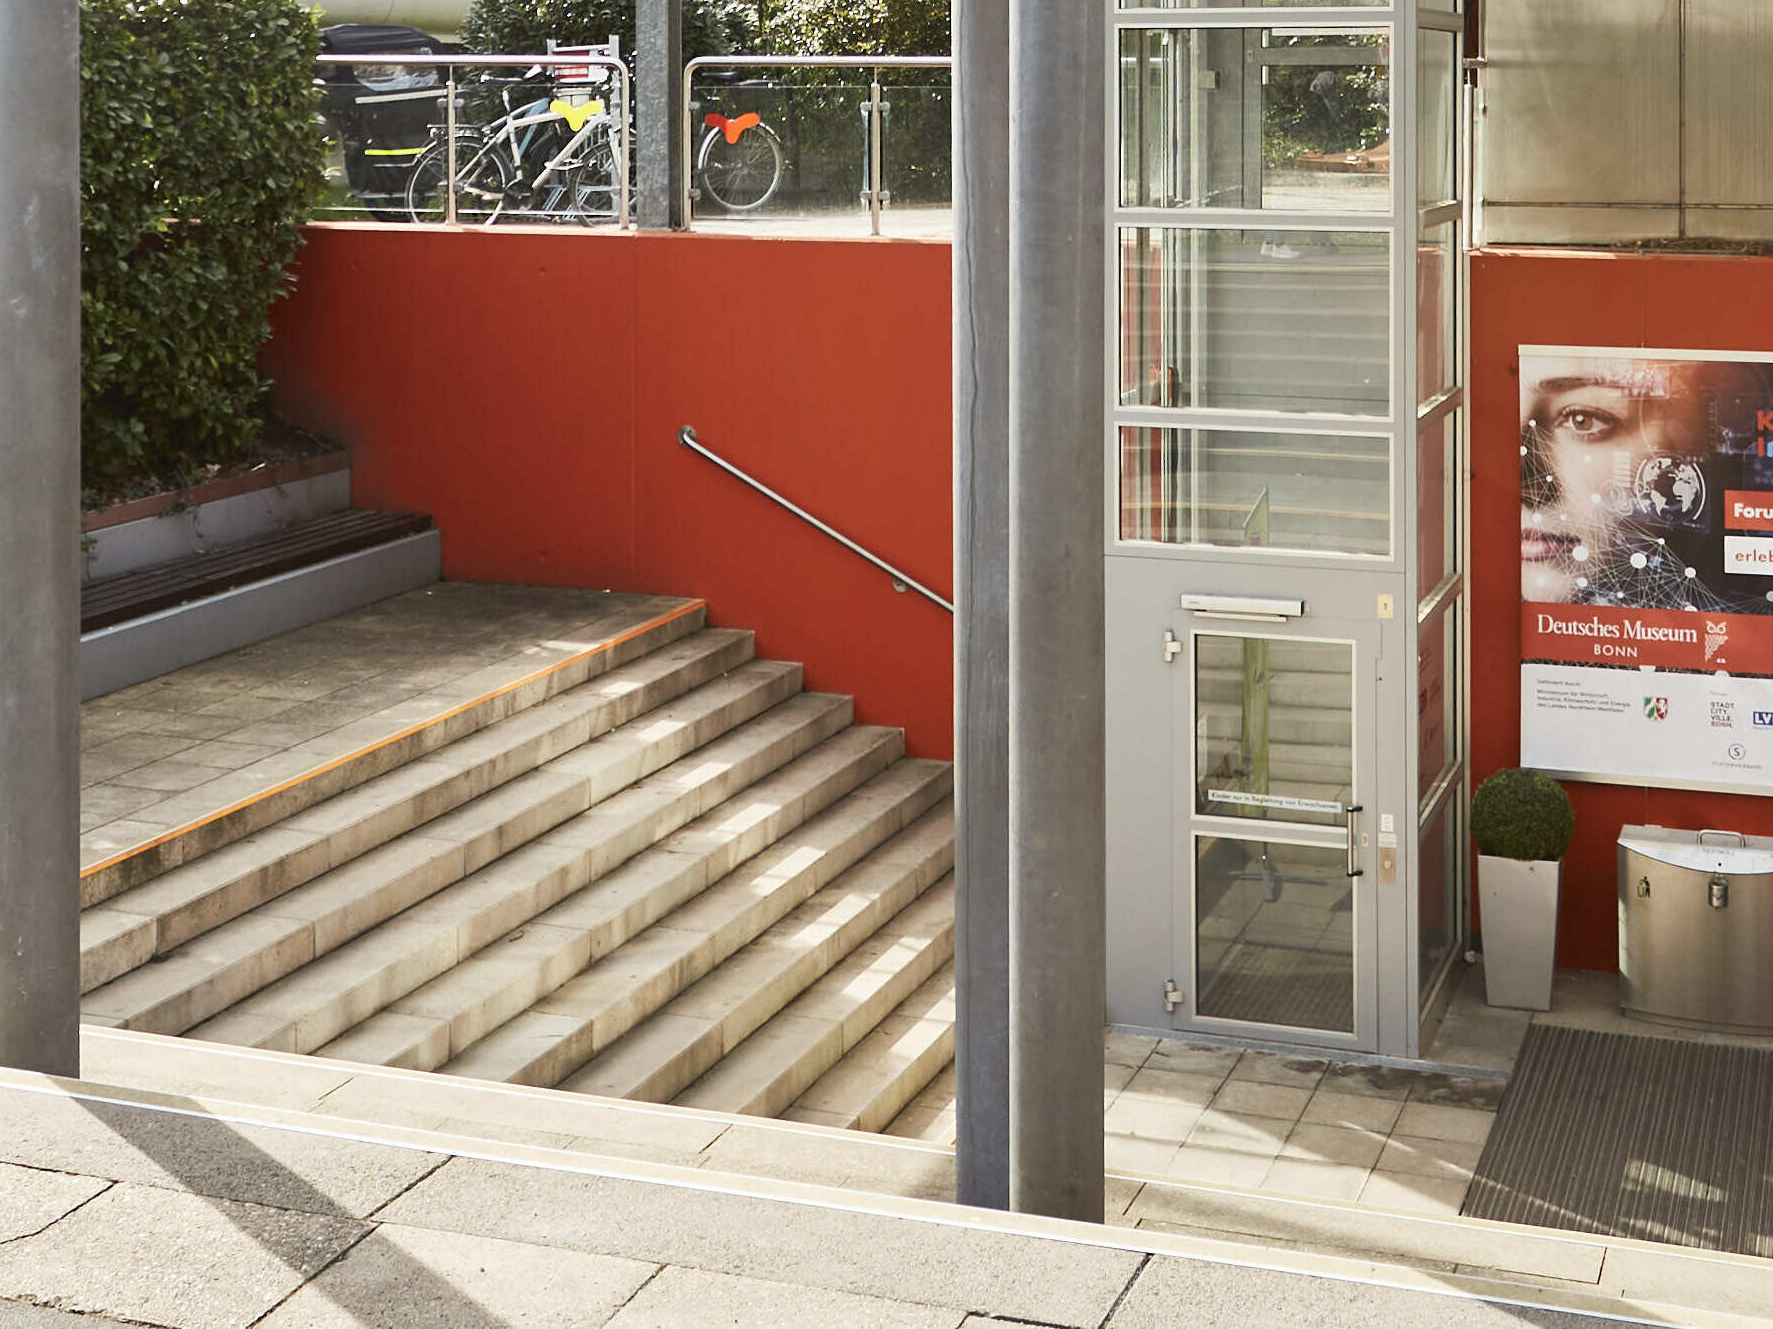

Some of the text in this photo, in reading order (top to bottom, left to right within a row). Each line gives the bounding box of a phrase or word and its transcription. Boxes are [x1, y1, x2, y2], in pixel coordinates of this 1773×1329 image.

[1537, 614, 1697, 643] Deutsches Museum
[1594, 644, 1638, 657] BONN
